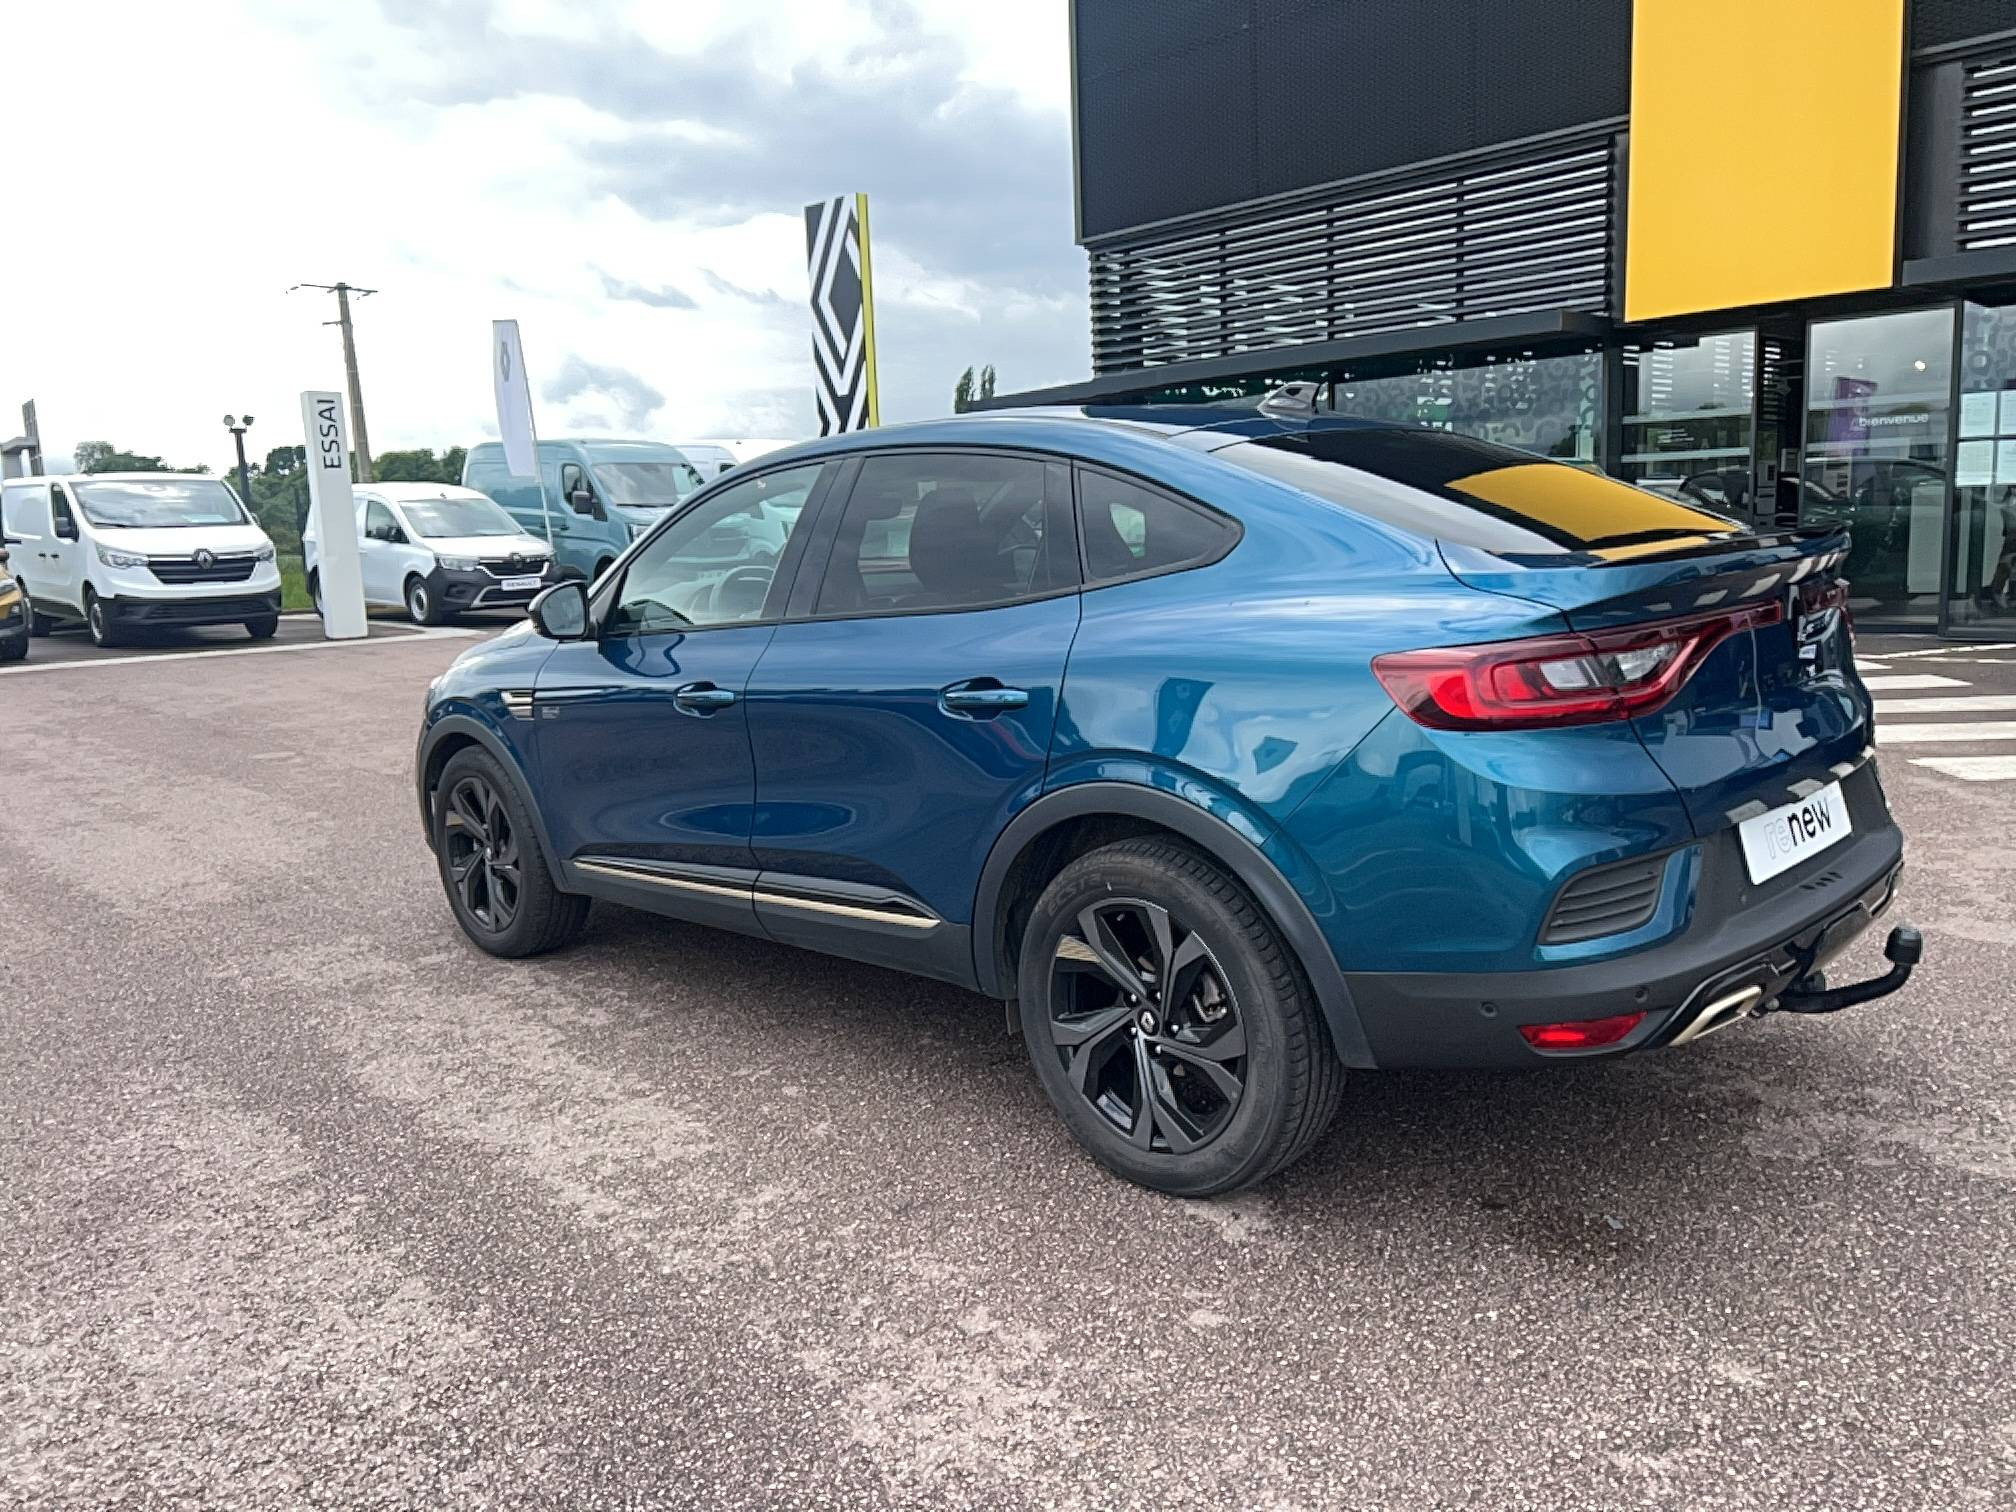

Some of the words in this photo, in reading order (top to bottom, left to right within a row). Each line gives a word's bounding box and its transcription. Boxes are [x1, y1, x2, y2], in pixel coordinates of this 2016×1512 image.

[316, 398, 342, 469] ESSAI
[1858, 413, 1929, 427] bienvenue
[1763, 796, 1831, 860] renew
